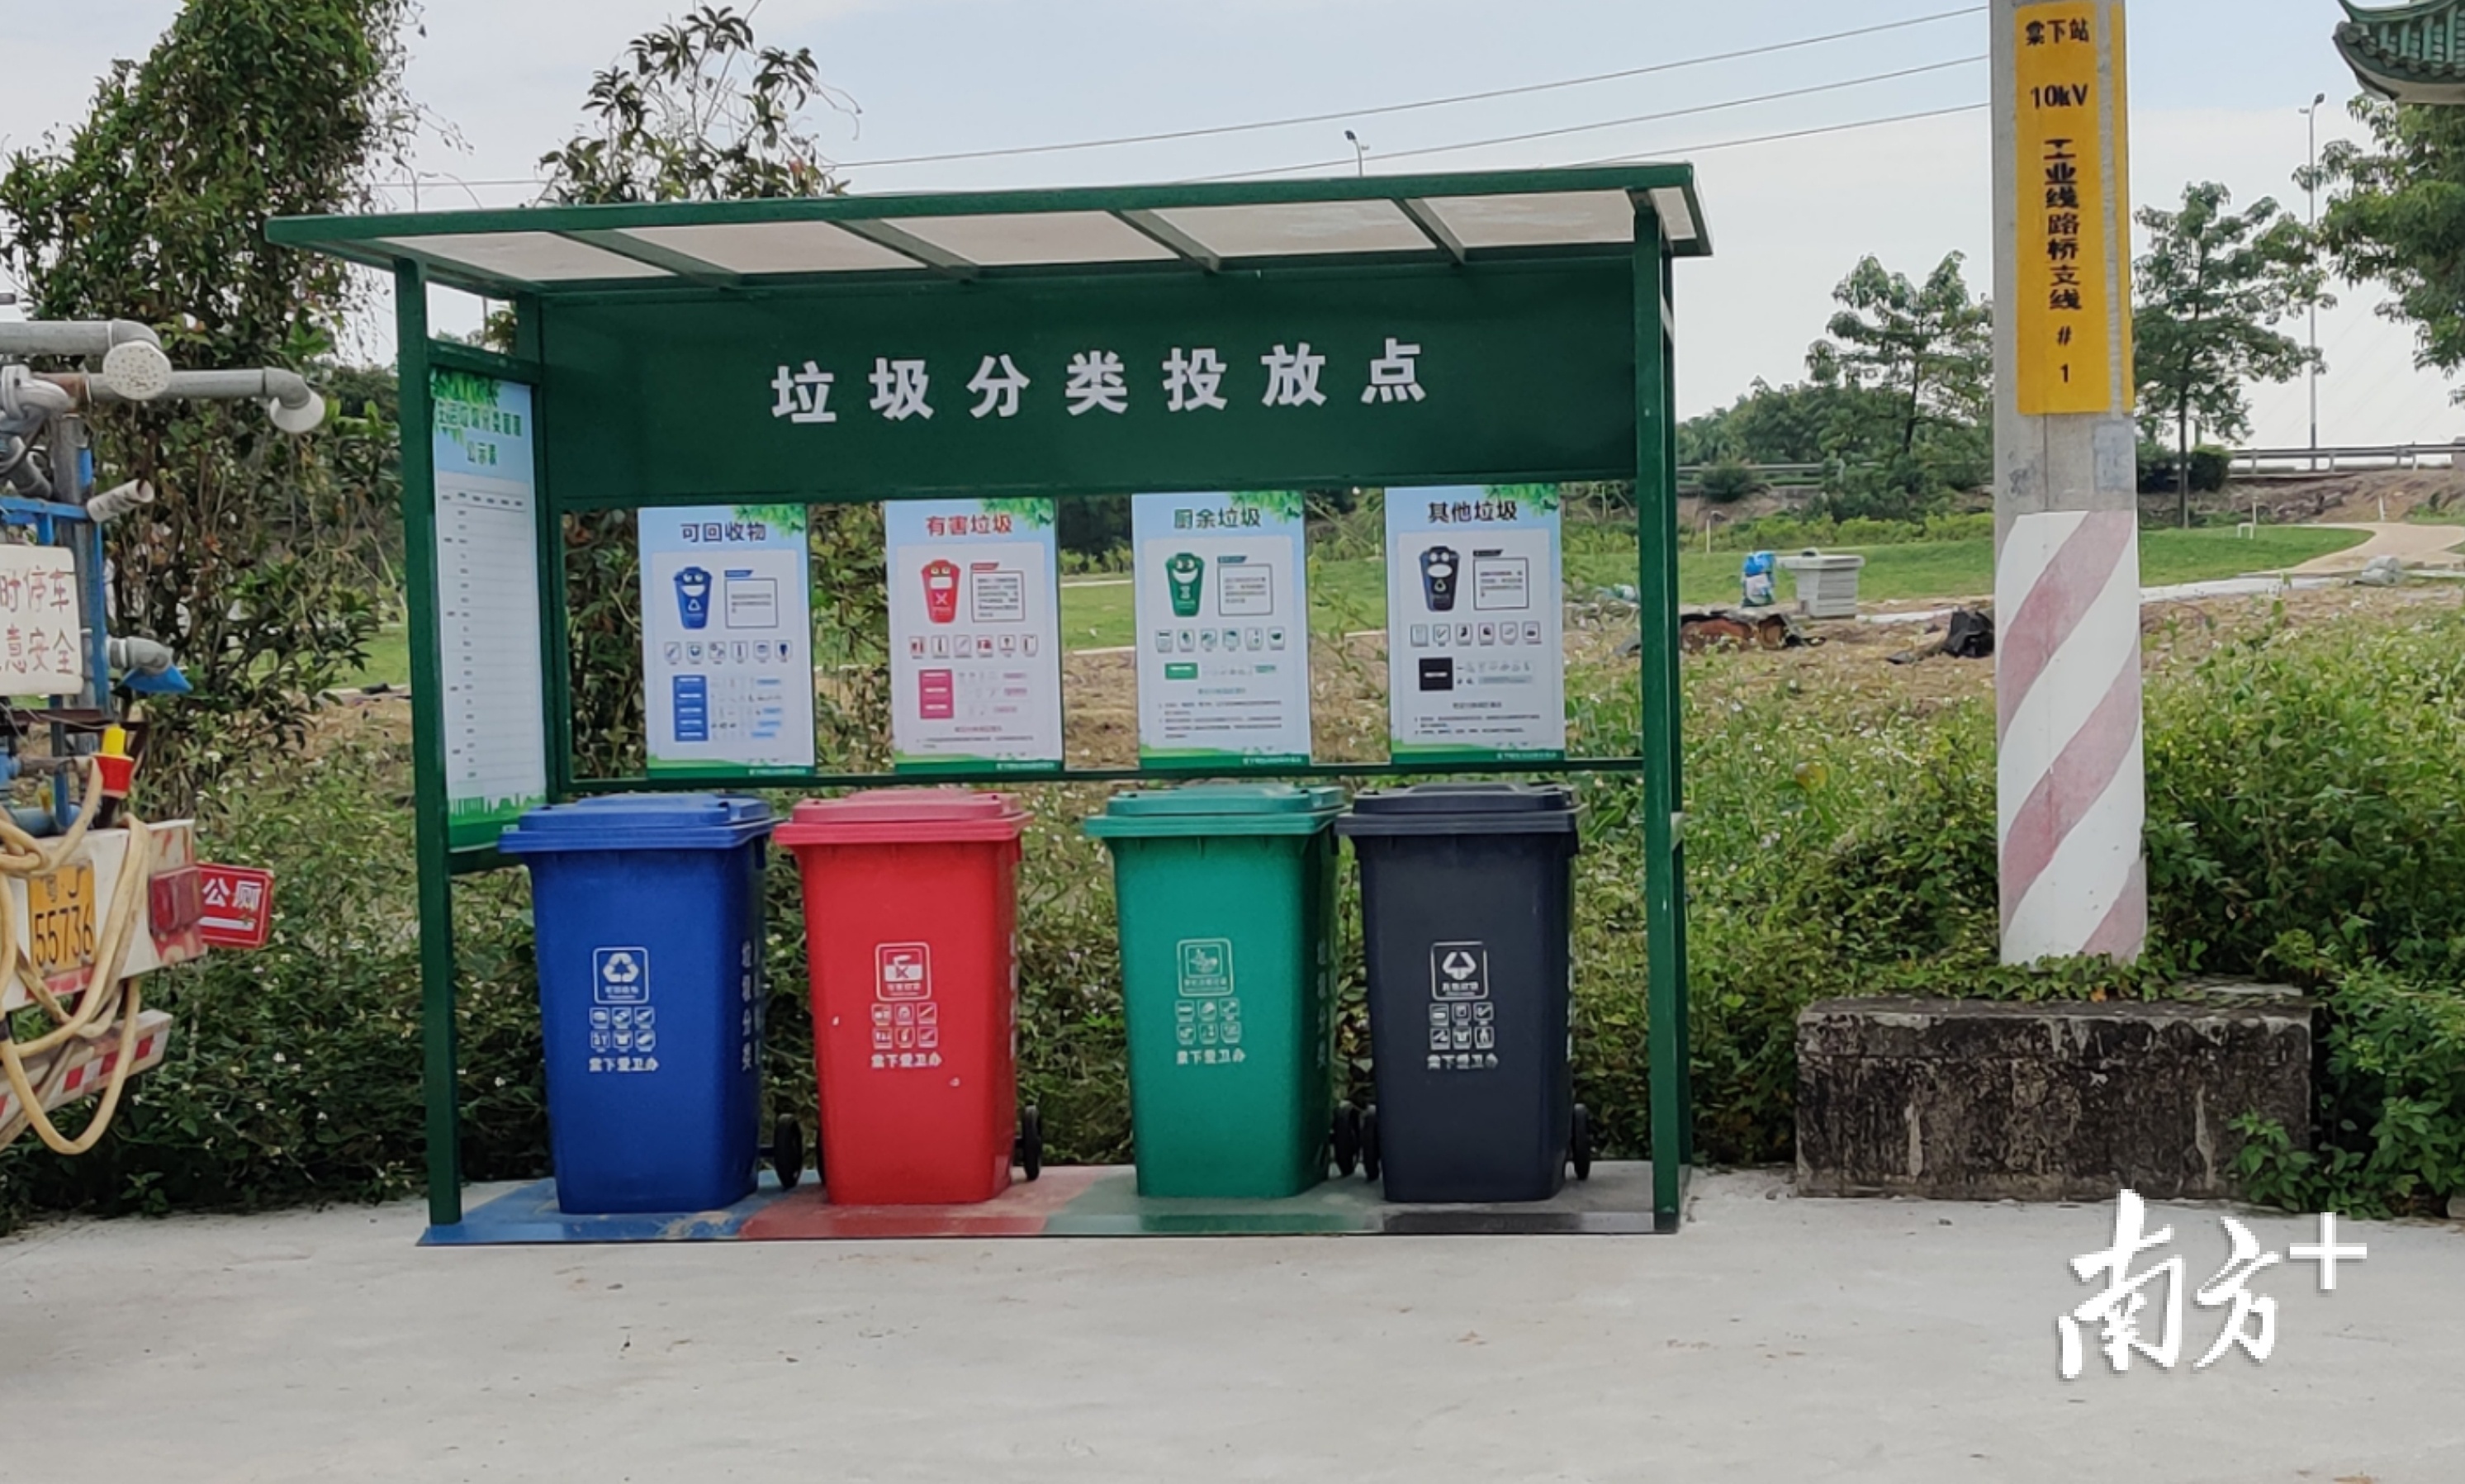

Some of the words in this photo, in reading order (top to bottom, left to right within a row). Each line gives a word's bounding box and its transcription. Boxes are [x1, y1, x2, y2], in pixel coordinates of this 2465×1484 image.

[2031, 83, 2088, 109] 10kV
[2043, 139, 2082, 311] 工业线路桥支线
[770, 337, 1426, 424] 垃圾分类投放点
[1173, 506, 1262, 529] 厨余垃圾
[1428, 500, 1518, 524] 其他垃圾
[680, 521, 766, 543] 可回收物
[926, 514, 1012, 537] 有害垃圾
[202, 878, 263, 909] 公厕
[34, 903, 93, 968] 55736
